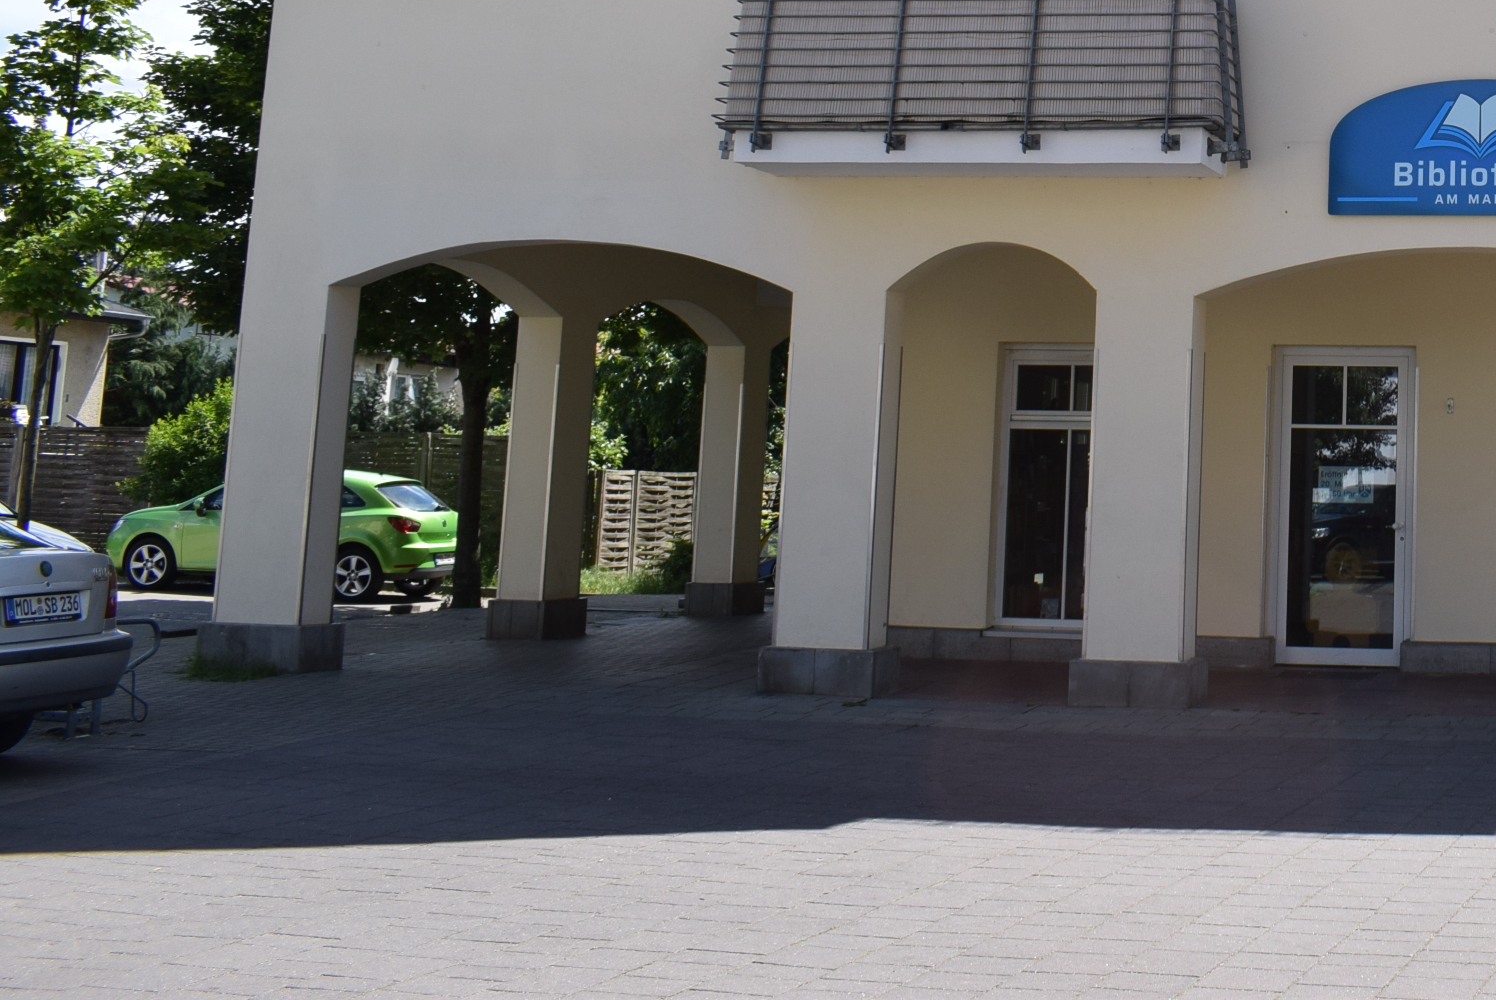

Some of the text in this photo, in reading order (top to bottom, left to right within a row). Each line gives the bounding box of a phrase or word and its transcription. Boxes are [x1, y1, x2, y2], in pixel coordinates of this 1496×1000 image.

[1434, 193, 1458, 205] AM
[15, 595, 79, 617] MOL SB 236
